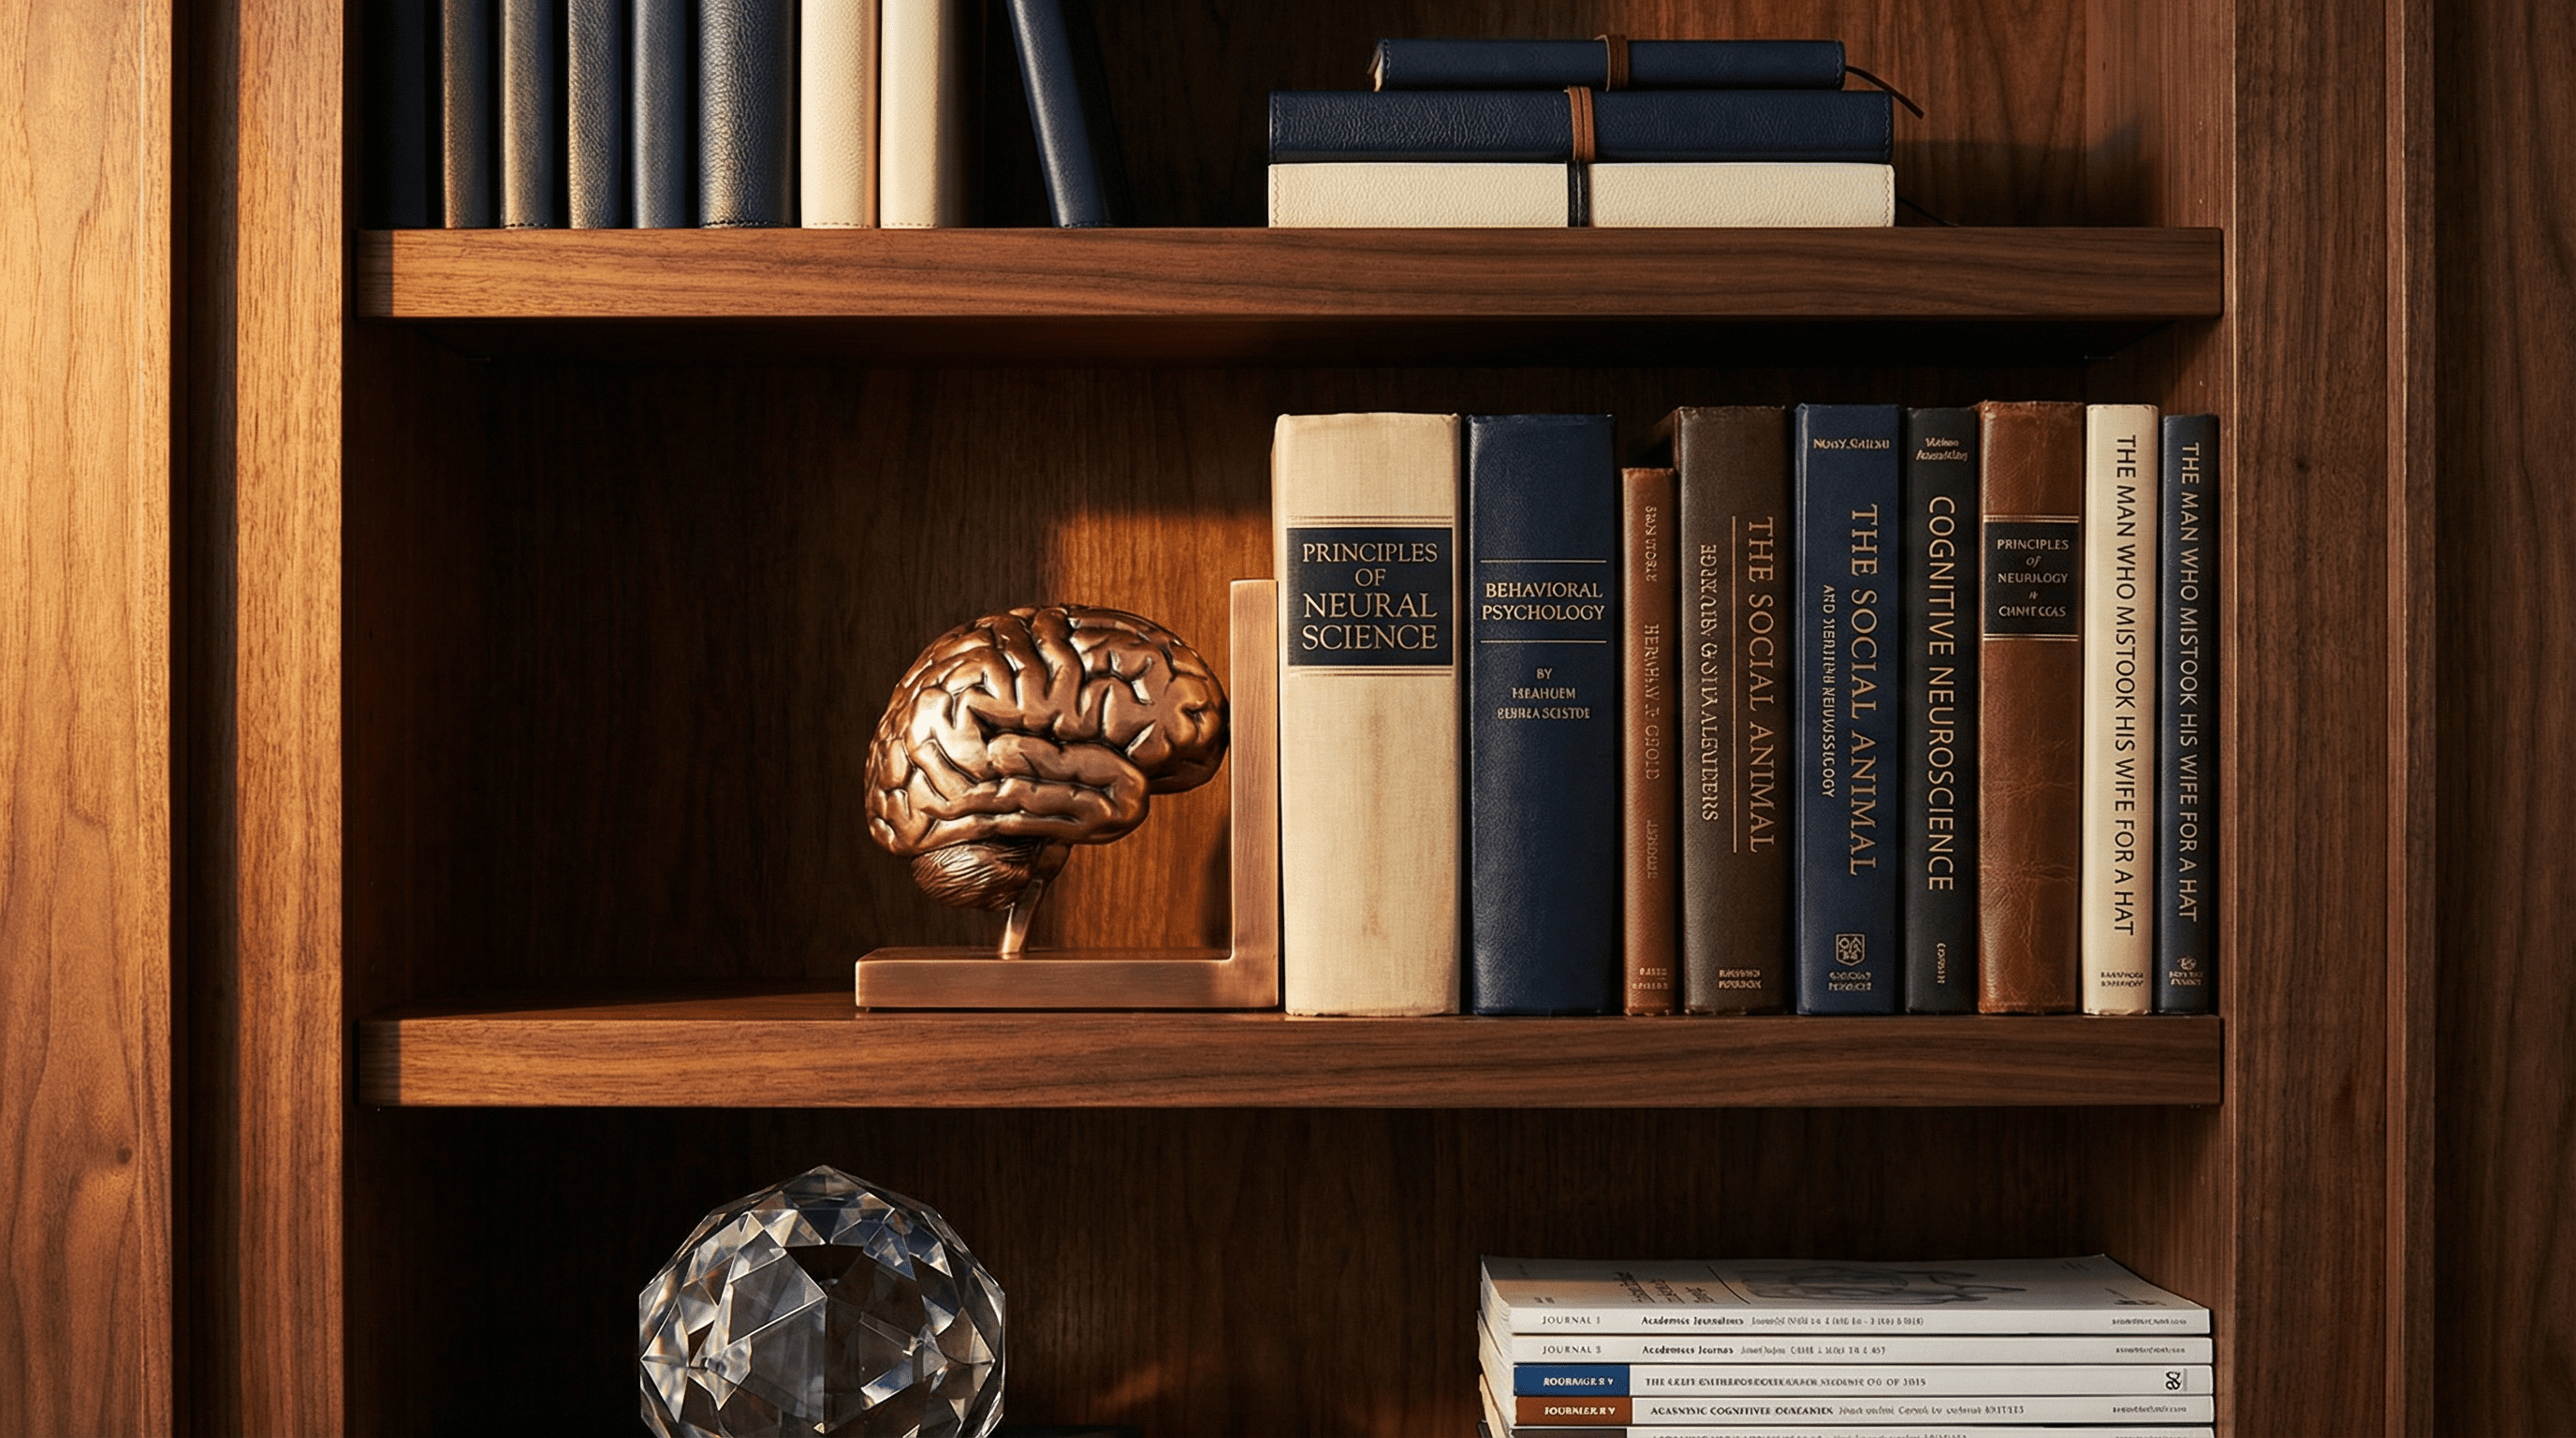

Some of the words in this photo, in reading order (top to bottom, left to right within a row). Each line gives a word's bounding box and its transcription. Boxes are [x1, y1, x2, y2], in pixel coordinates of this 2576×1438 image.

[2116, 434, 2137, 478] THE
[2181, 442, 2200, 484] THE
[2116, 485, 2136, 537] MAN
[2180, 492, 2199, 541] MAN
[1302, 542, 1438, 563] PRINCIPLES
[1748, 516, 1775, 583] THE
[1851, 503, 1878, 577] THE
[1997, 538, 2069, 550] PRINCIPLES
[1354, 568, 1386, 587] OF
[1486, 581, 1604, 598] BEHAVIORAL
[1928, 496, 1955, 655] COGNITIVE
[2115, 543, 2136, 600] WHO
[2180, 548, 2199, 601] WHO
[1303, 593, 1438, 618] NEURAL
[1482, 604, 1605, 621] PSYCHOLOGY
[1302, 624, 1438, 651] SCIENCE
[1748, 594, 1775, 712] SOCIAL
[1851, 589, 1878, 720] SOCIAL
[2115, 606, 2135, 709] MISTOOK
[2179, 608, 2199, 706] MISTOOK
[1536, 668, 1553, 680] BY
[2115, 716, 2136, 752] HIS
[2180, 713, 2198, 746] HIS
[1749, 721, 1776, 853] ANIMAL
[1927, 667, 1954, 890] NEUROSCIENCE
[2115, 757, 2135, 812] WIFE
[2179, 755, 2198, 804] WIFE
[1850, 730, 1877, 875] ANIMAL
[2115, 819, 2135, 862] FOR
[2179, 812, 2198, 852] FOR
[2115, 869, 2134, 884] A
[2178, 858, 2197, 873] A
[2114, 891, 2134, 936] HAT
[2179, 879, 2197, 922] HAT
[1542, 1315, 1592, 1325] JOURNAL
[1542, 1345, 1592, 1355] JOURNAL
